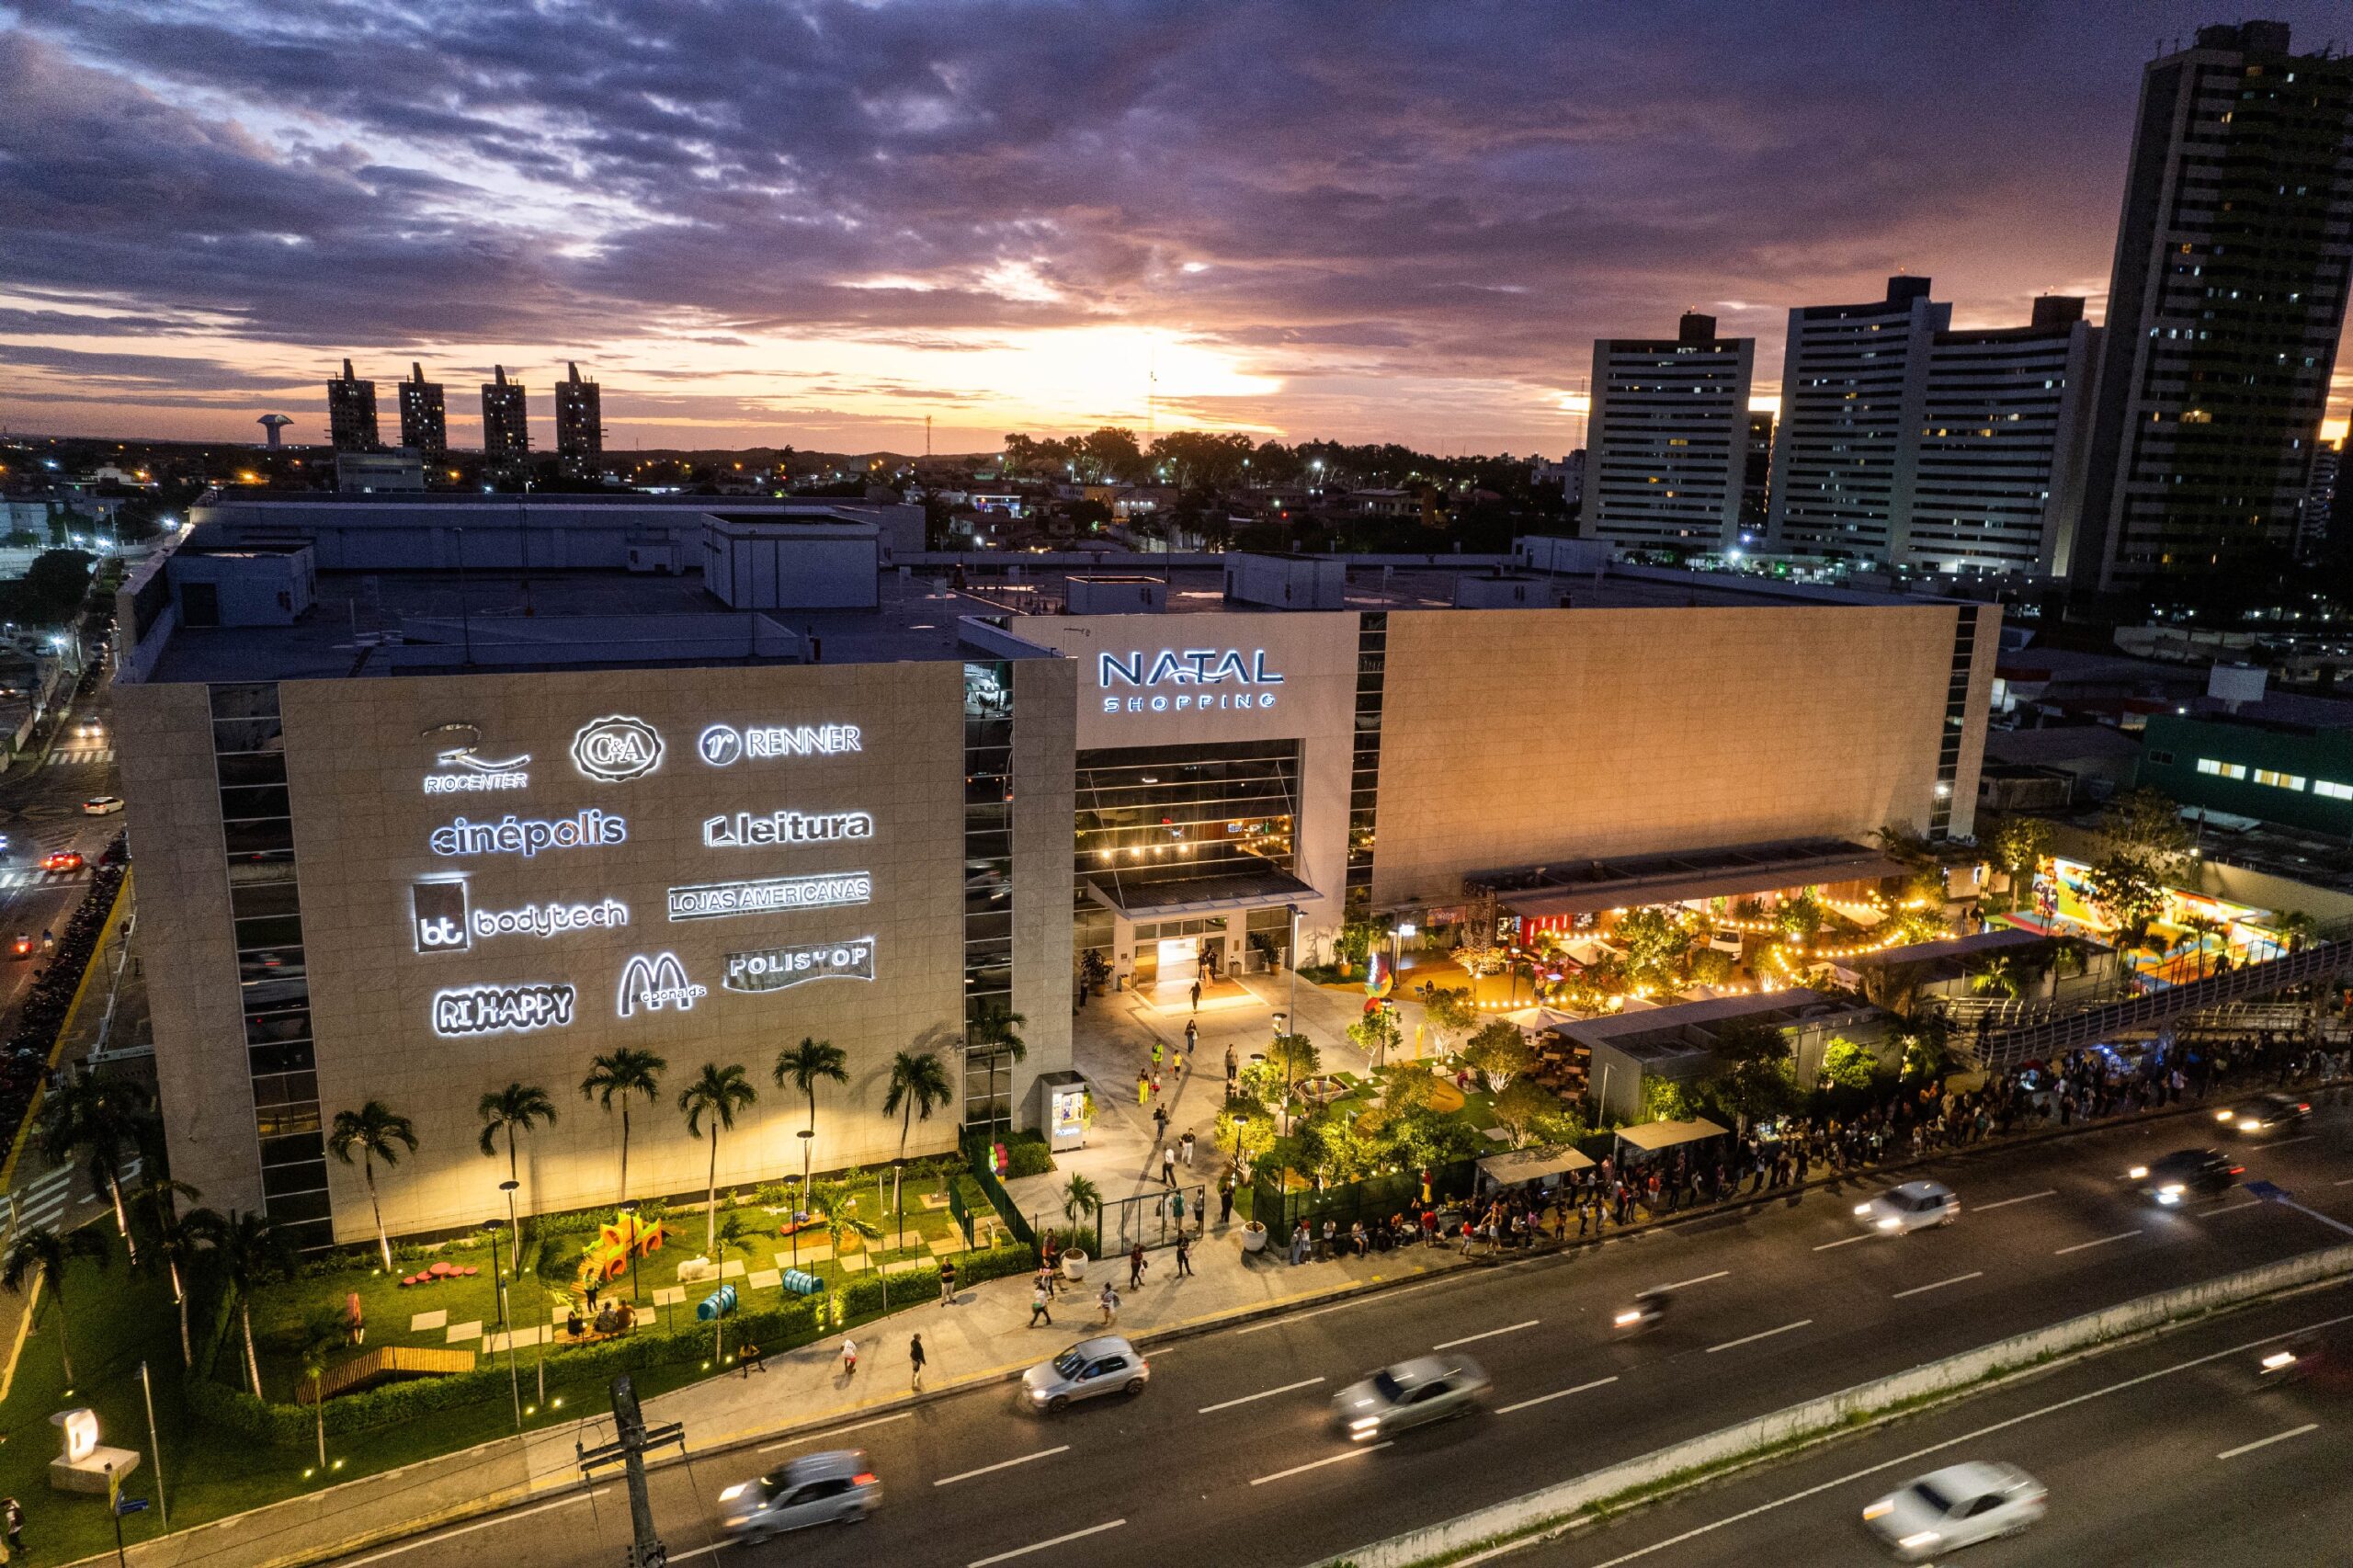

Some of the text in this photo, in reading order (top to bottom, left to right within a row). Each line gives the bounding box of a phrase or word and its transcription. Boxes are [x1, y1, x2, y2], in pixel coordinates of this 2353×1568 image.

[1099, 649, 1284, 687] NATAL
[1104, 693, 1276, 712] SHOPPING
[590, 733, 647, 763] C&A
[746, 726, 861, 756] RENNER
[425, 774, 529, 793] RIOCENTER
[431, 809, 626, 856] cinépolis
[738, 812, 871, 846] leitura
[670, 880, 870, 914] LOJAS AMERICANAS
[420, 900, 627, 945] bt bodytech
[477, 989, 572, 1027] HAPPY
